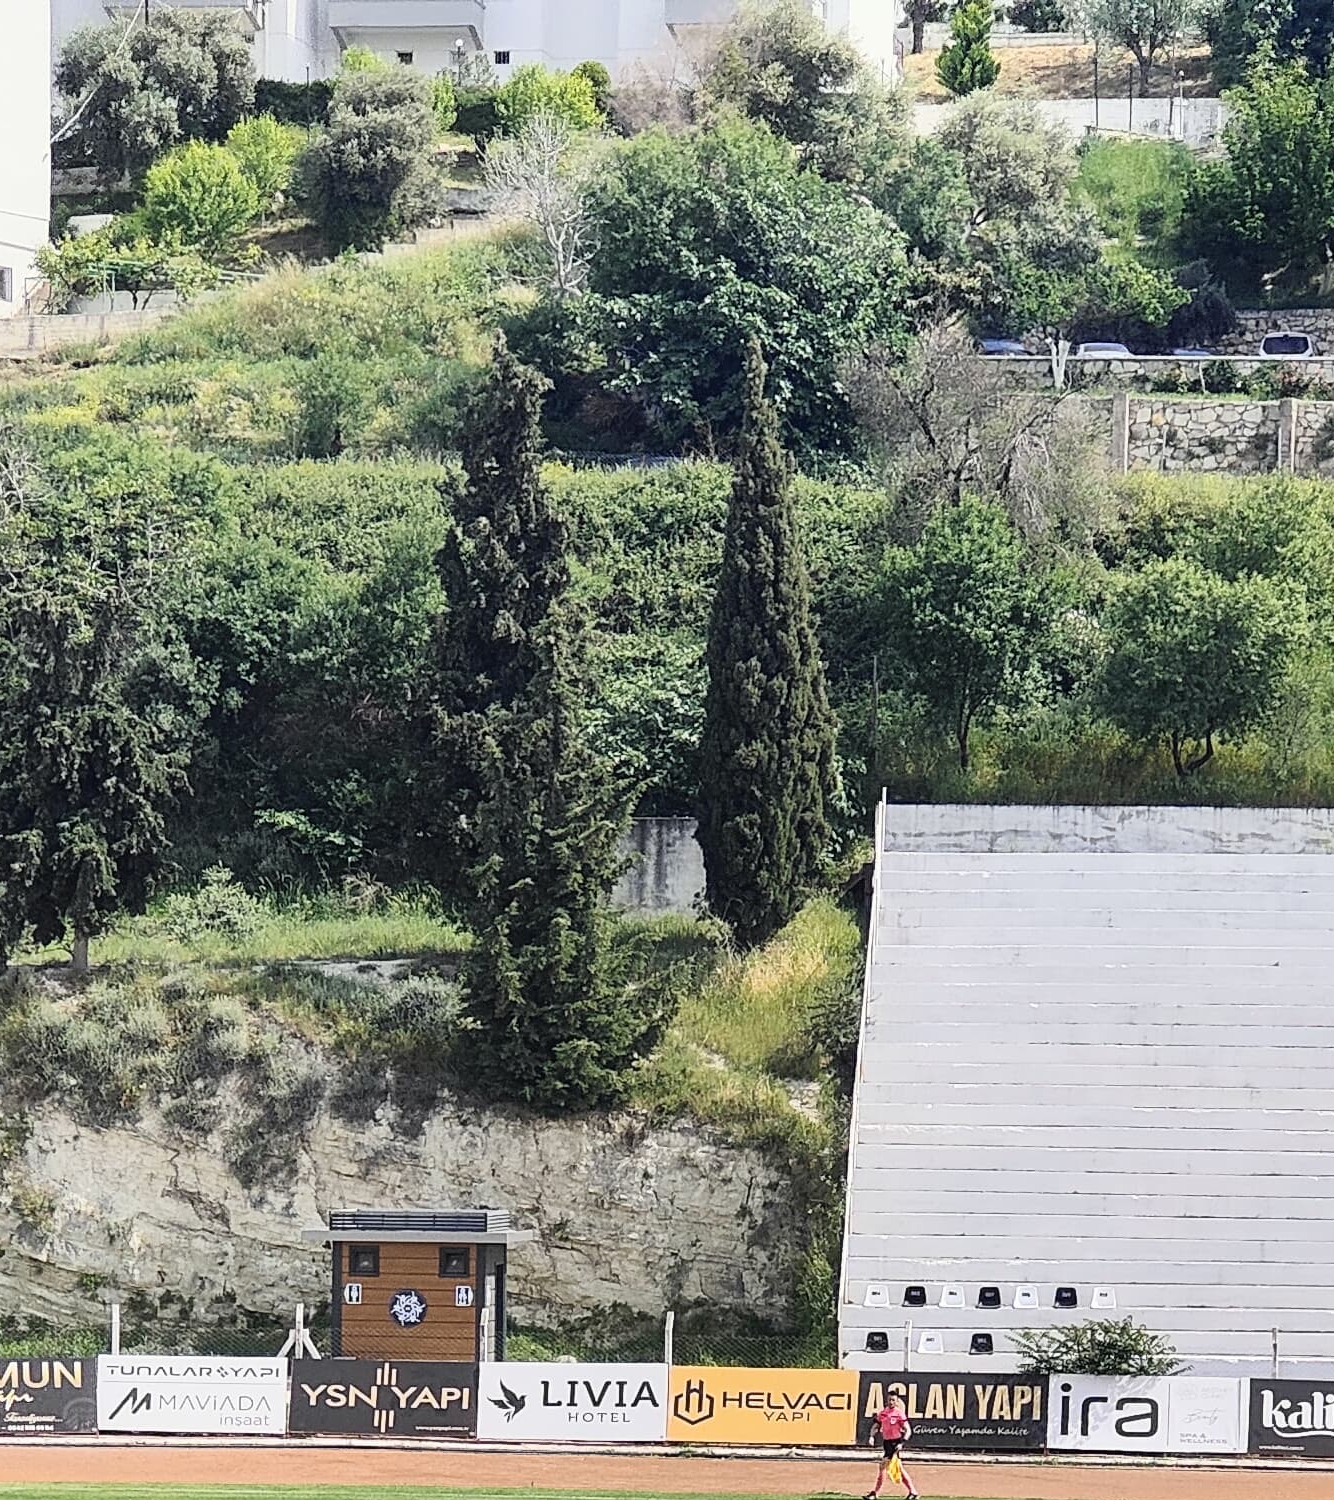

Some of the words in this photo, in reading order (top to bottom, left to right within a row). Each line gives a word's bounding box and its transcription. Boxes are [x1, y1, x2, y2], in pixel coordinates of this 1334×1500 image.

[107, 1365, 212, 1377] TUNALAR
[230, 1367, 279, 1378] YAPI
[301, 1383, 378, 1409] YSN
[391, 1386, 470, 1410] YAPI
[540, 1380, 660, 1408] LIVIA
[722, 1391, 852, 1410] HELVACI
[974, 1384, 1042, 1421] YAPI
[568, 1412, 631, 1423] HOTEL
[763, 1411, 811, 1422] YAPI
[1060, 1382, 1159, 1438] ira
[219, 1415, 270, 1426] inşaat
